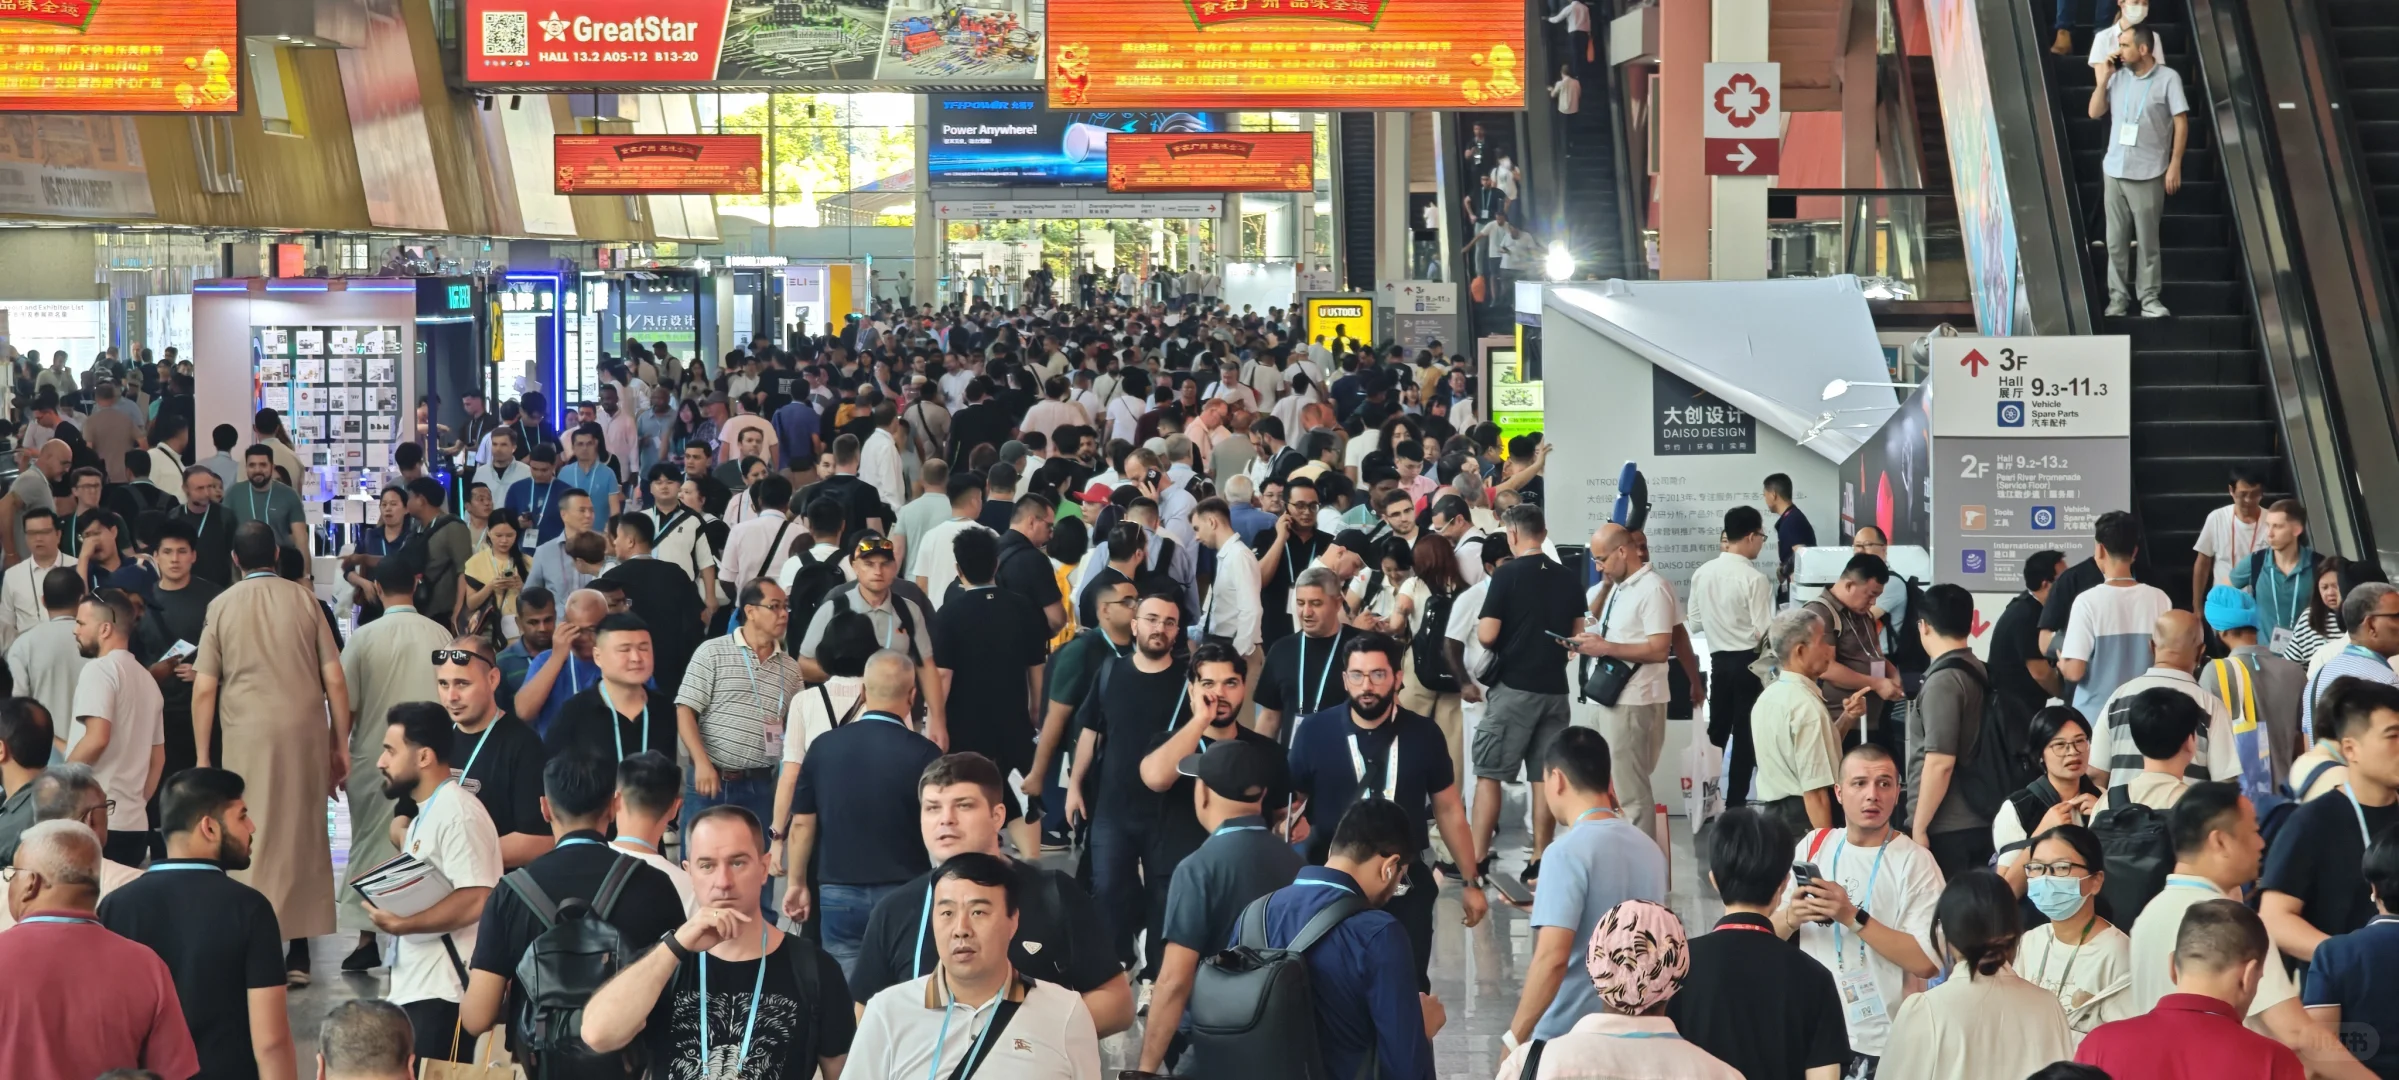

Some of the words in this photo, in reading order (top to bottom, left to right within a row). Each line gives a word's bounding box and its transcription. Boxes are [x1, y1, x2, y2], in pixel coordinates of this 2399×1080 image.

[573, 16, 698, 42] GreatStar
[539, 52, 569, 62] HALL
[573, 52, 600, 62] 13.2
[603, 52, 648, 62] A05-12
[655, 52, 698, 62] B13-20
[943, 125, 977, 135] Power
[979, 124, 1038, 137] Anywhere!
[643, 314, 695, 327] 风行设计
[2000, 348, 2028, 371] 3F
[1999, 376, 2023, 386] Hall
[2031, 377, 2108, 396] 9.3-11.3
[1999, 388, 2024, 398] 展厅
[1663, 405, 1745, 425] 大创设计
[2031, 410, 2056, 419] Spare
[2031, 419, 2067, 427] 汽车配件
[1663, 429, 1699, 438] DAISO
[1702, 427, 1746, 437] DESIGN
[1961, 454, 1990, 478] 2F
[2016, 456, 2068, 468] 9.2-13.2
[1652, 476, 1687, 485] 公司简介
[1996, 473, 2016, 481] Pearl
[2017, 473, 2036, 481] River
[2038, 473, 2081, 481] Promenade
[1994, 519, 2009, 527] 工具
[1658, 561, 1683, 570] DAISO
[1685, 560, 1704, 569] DES
